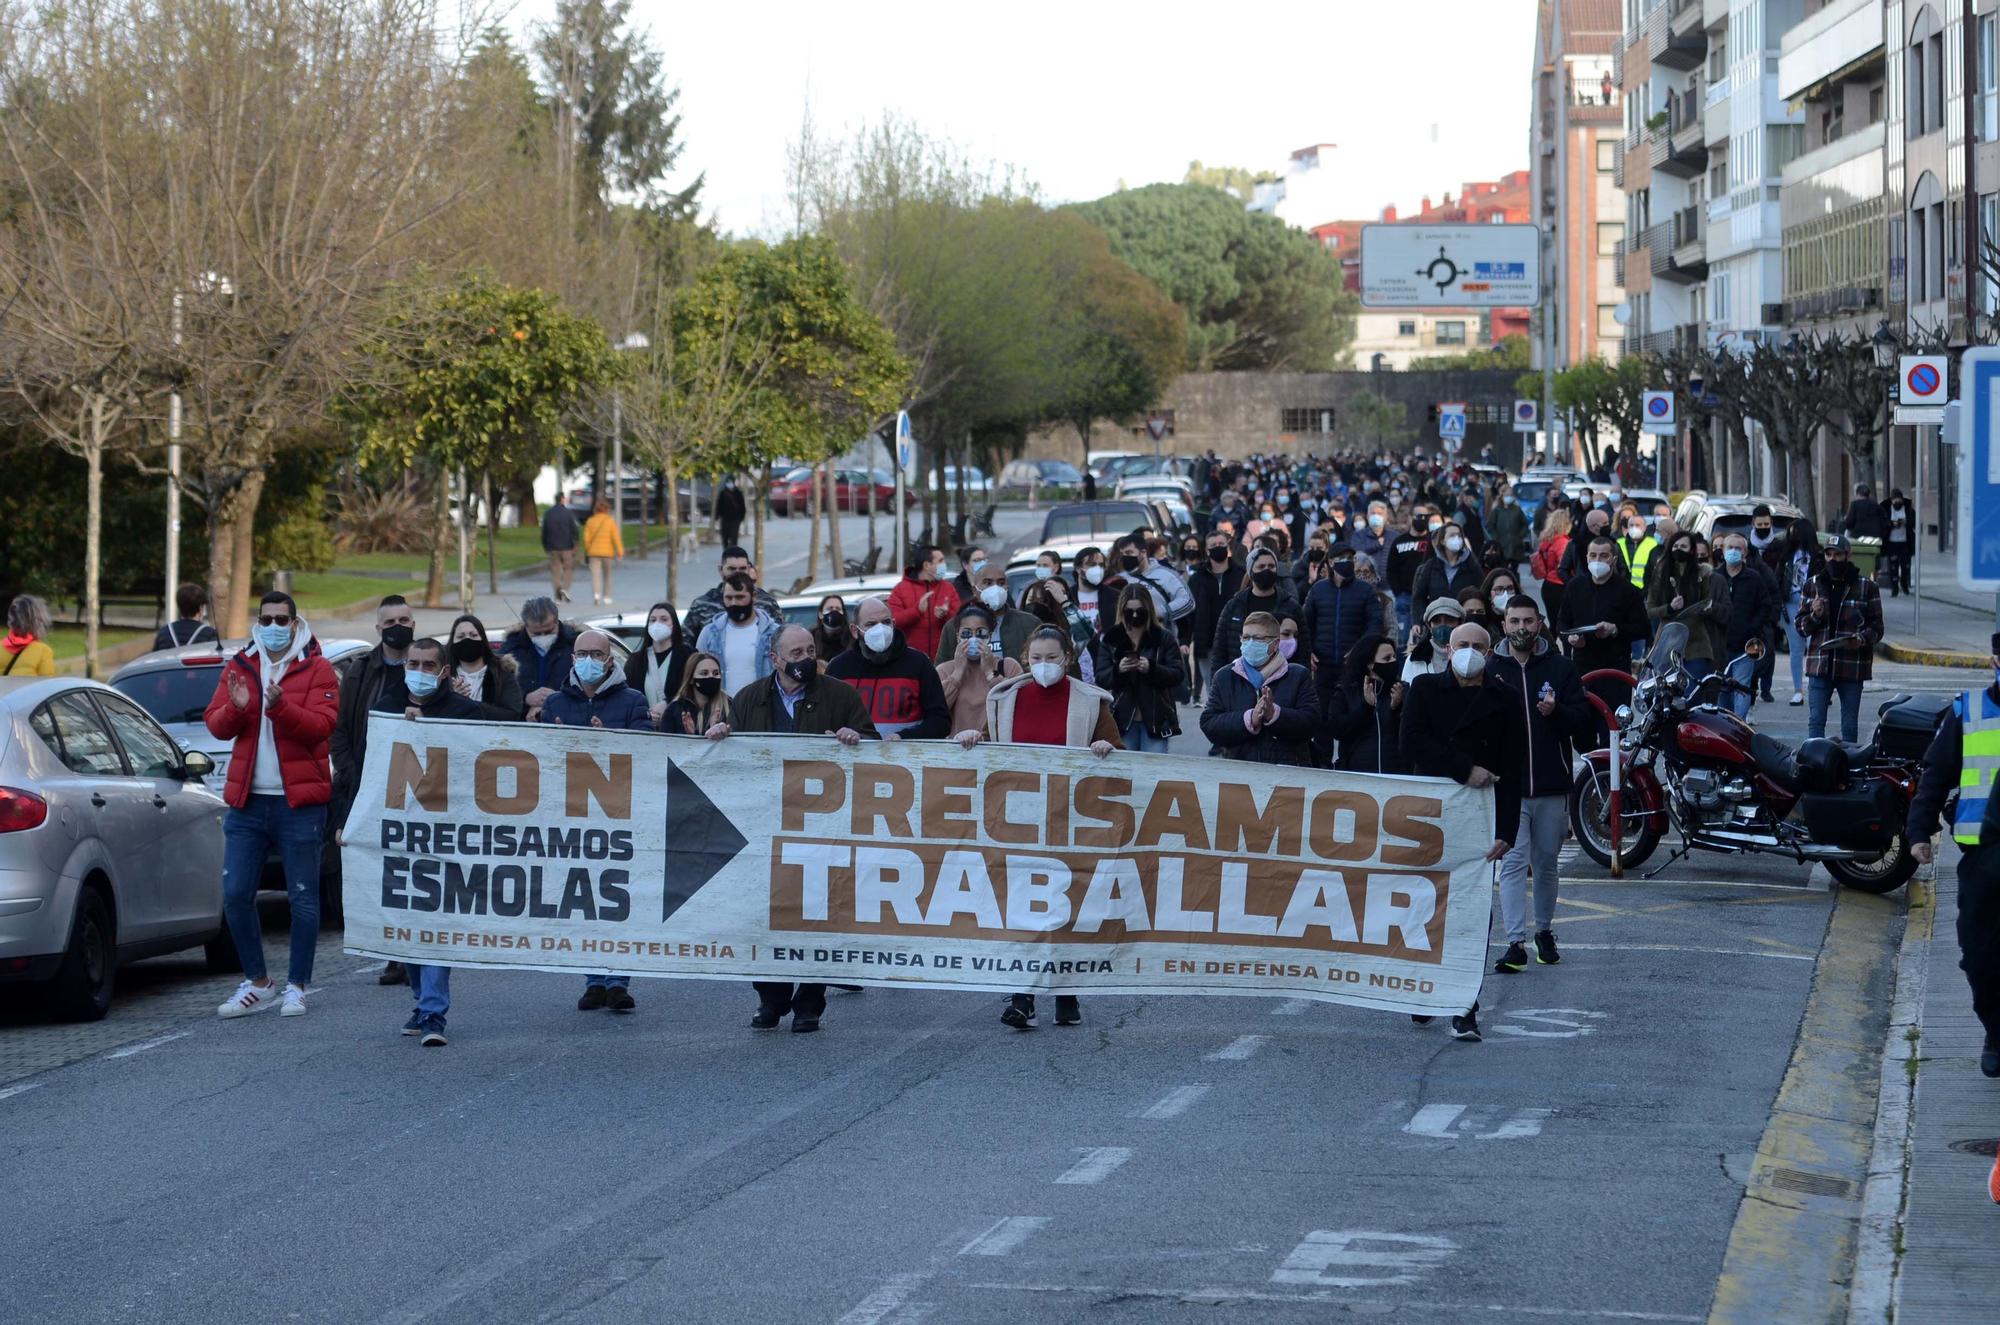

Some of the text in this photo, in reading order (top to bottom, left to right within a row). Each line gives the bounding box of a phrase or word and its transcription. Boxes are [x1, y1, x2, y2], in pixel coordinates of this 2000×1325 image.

[385, 741, 633, 820] NON
[381, 818, 634, 861] PRECISAMOS
[781, 760, 1444, 867] PRECISAMOS
[381, 856, 631, 923] ESMOLAS
[781, 843, 1437, 952] TRABALLAR
[383, 926, 736, 959] EN DEFENSA DA HOSTELERÍA
[773, 947, 1114, 974] EN DEFENSA DE VILAGARCIA
[1164, 959, 1435, 995] EN DEFENSA DO NOSO
